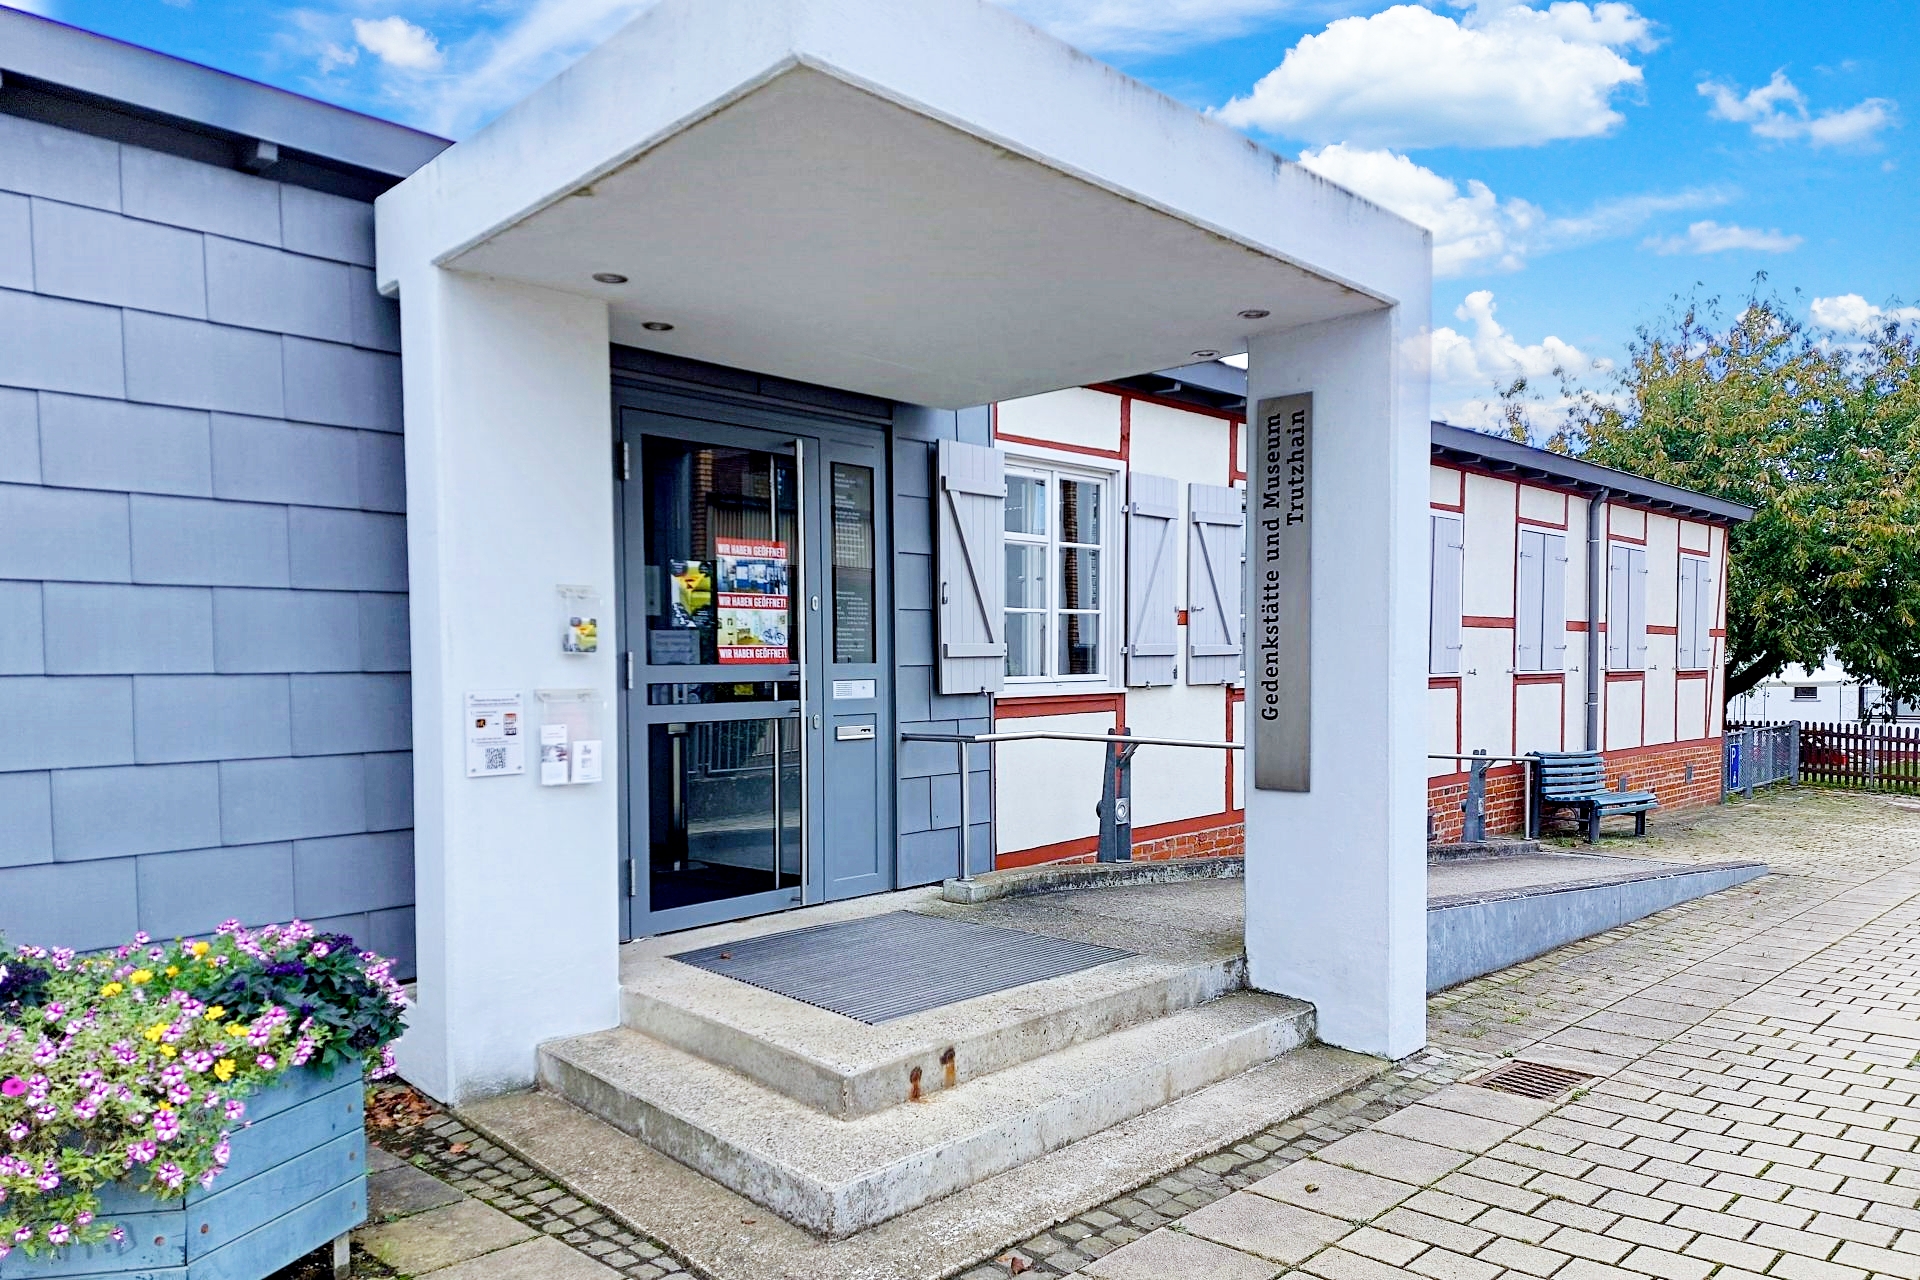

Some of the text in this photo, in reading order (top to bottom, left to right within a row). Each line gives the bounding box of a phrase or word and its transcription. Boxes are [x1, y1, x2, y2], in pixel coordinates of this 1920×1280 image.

[1287, 409, 1305, 526] Trutzhain
[717, 543, 786, 558] WIR HABEN GEÖFFNET!
[1261, 413, 1281, 720] Gedenkstätte und Museum
[718, 596, 786, 608] WIR HABEN GEÖFFNET!
[719, 647, 787, 659] WIR HABEN GEÖFFNET!
[1731, 747, 1737, 765] P
